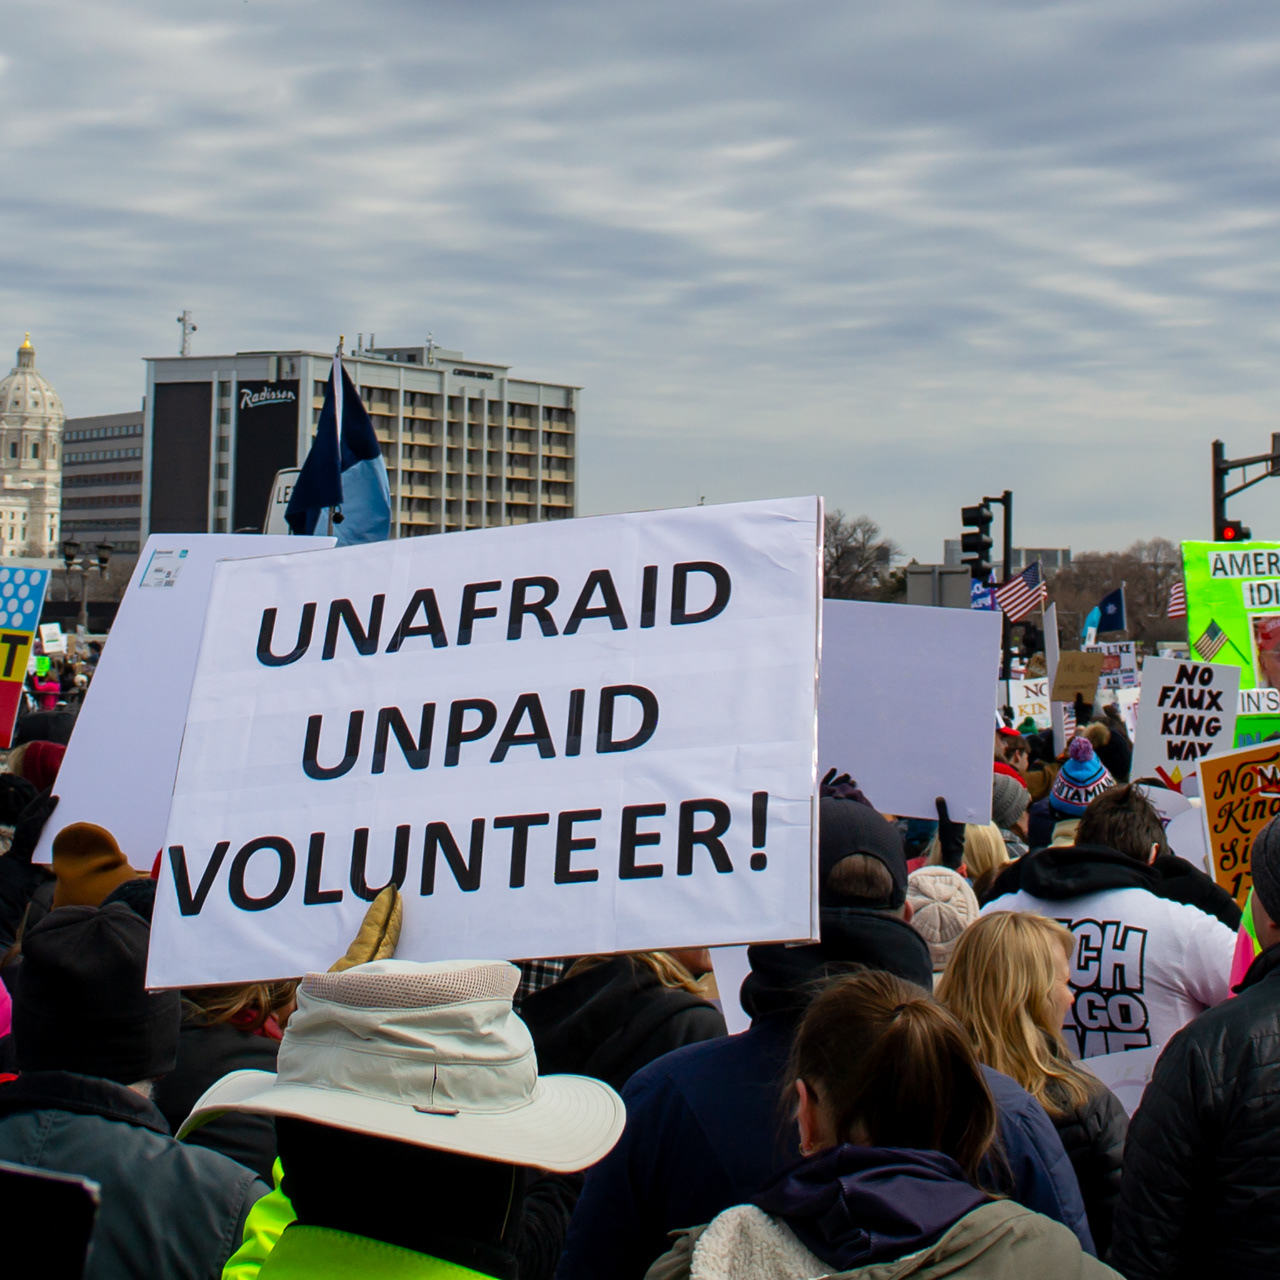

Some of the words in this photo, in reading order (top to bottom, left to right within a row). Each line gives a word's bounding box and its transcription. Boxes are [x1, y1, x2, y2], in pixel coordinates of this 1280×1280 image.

[240, 386, 296, 409] Radisson
[256, 561, 732, 667] UNAFRAID
[1175, 664, 1214, 686] NO
[1157, 685, 1224, 712] FAUX
[302, 684, 659, 781] UNPAID
[1161, 712, 1222, 738] KING
[1166, 740, 1214, 762] WAY
[1214, 752, 1280, 800] No
[168, 791, 770, 917] VOLUNTEER!
